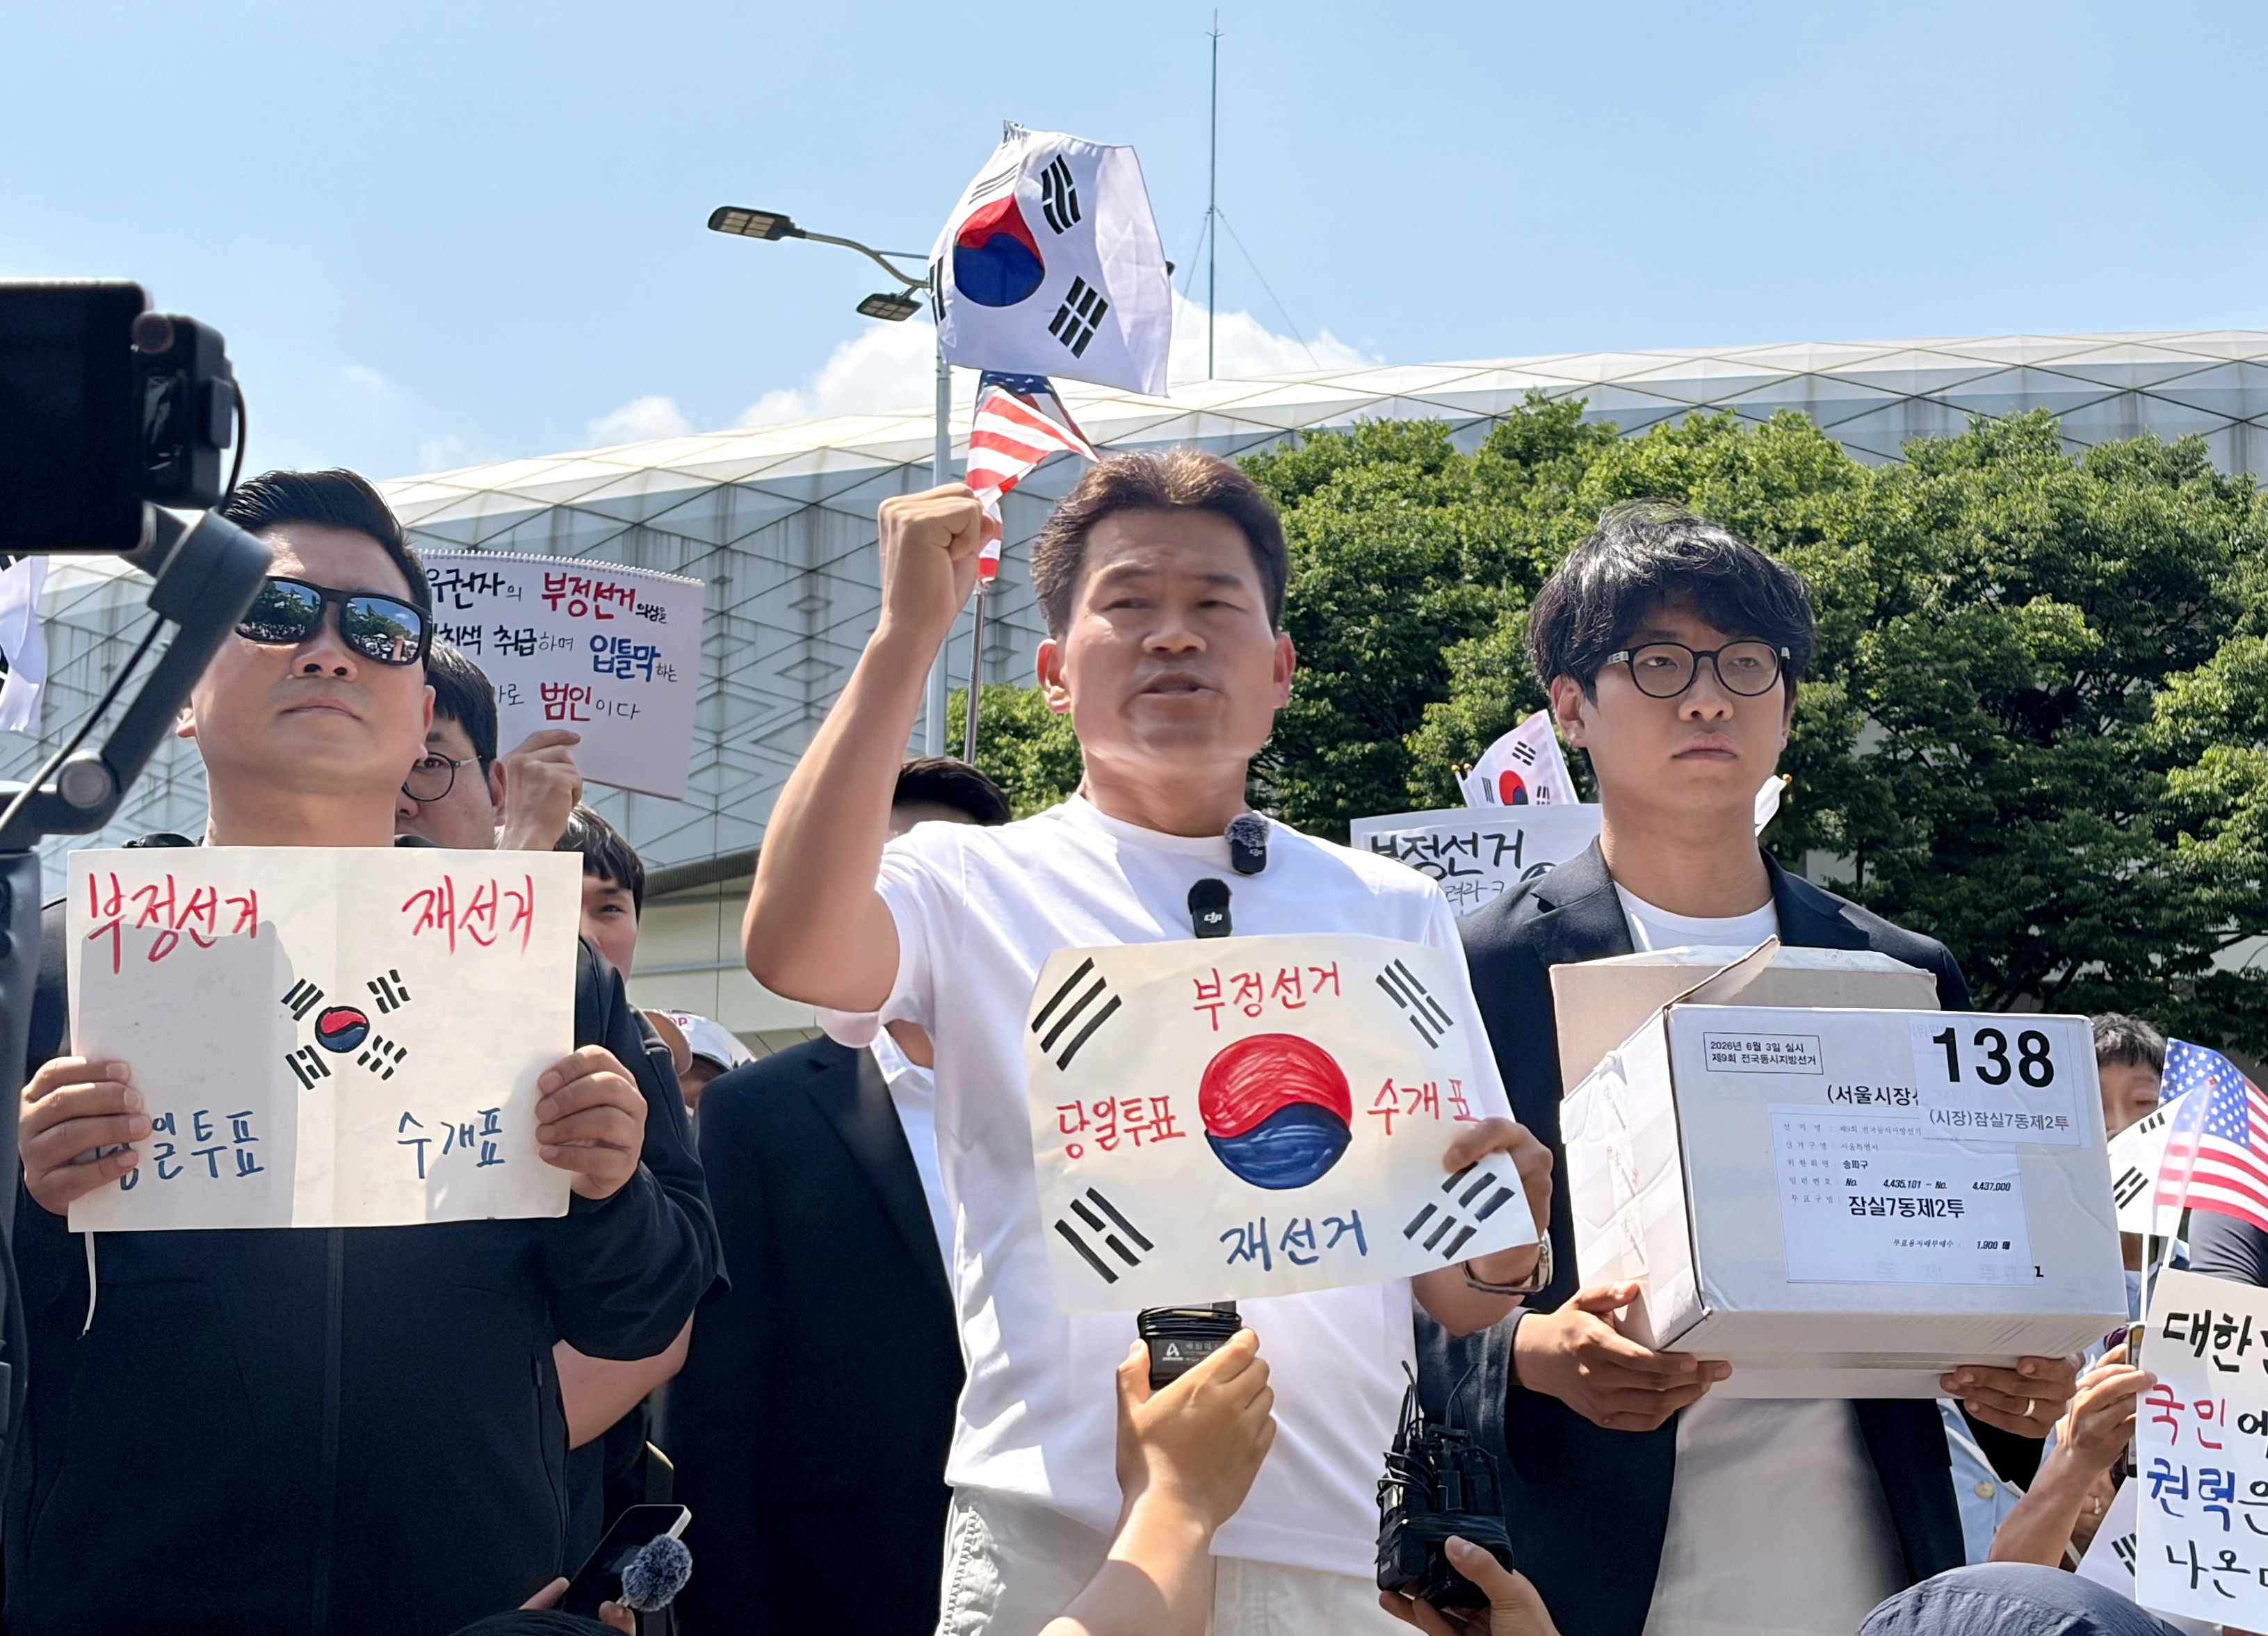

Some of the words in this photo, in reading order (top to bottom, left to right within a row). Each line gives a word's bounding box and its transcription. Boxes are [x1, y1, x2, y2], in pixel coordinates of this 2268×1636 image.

[542, 572, 635, 619] 부정선거
[434, 622, 483, 656] 치색
[493, 624, 574, 657] 취급하며
[540, 682, 642, 721] 범인이다
[88, 872, 258, 974] 부정선거
[401, 873, 536, 955] 재선거
[1204, 912, 1222, 923] dji
[1193, 961, 1341, 1032] 부정선거
[1710, 1041, 1742, 1051] 2026년
[1746, 1042, 1762, 1052] 6월
[1765, 1043, 1781, 1053] 3일
[1785, 1043, 1804, 1053] 실시
[1712, 1053, 1737, 1063] 제9회
[1741, 1054, 1817, 1065] 전국동시지방선거
[1932, 1027, 2055, 1088] 138
[1055, 1094, 1187, 1159] 당일투표
[1366, 1078, 1487, 1136] 수개표
[397, 1107, 506, 1180] 수개표
[1842, 1160, 1868, 1170] 송파구
[1848, 1196, 1966, 1218] 잠실7동제2투
[1220, 1208, 1369, 1272] 재선거
[2162, 1309, 2268, 1374] 대한
[2166, 1539, 2268, 1599] 나온
